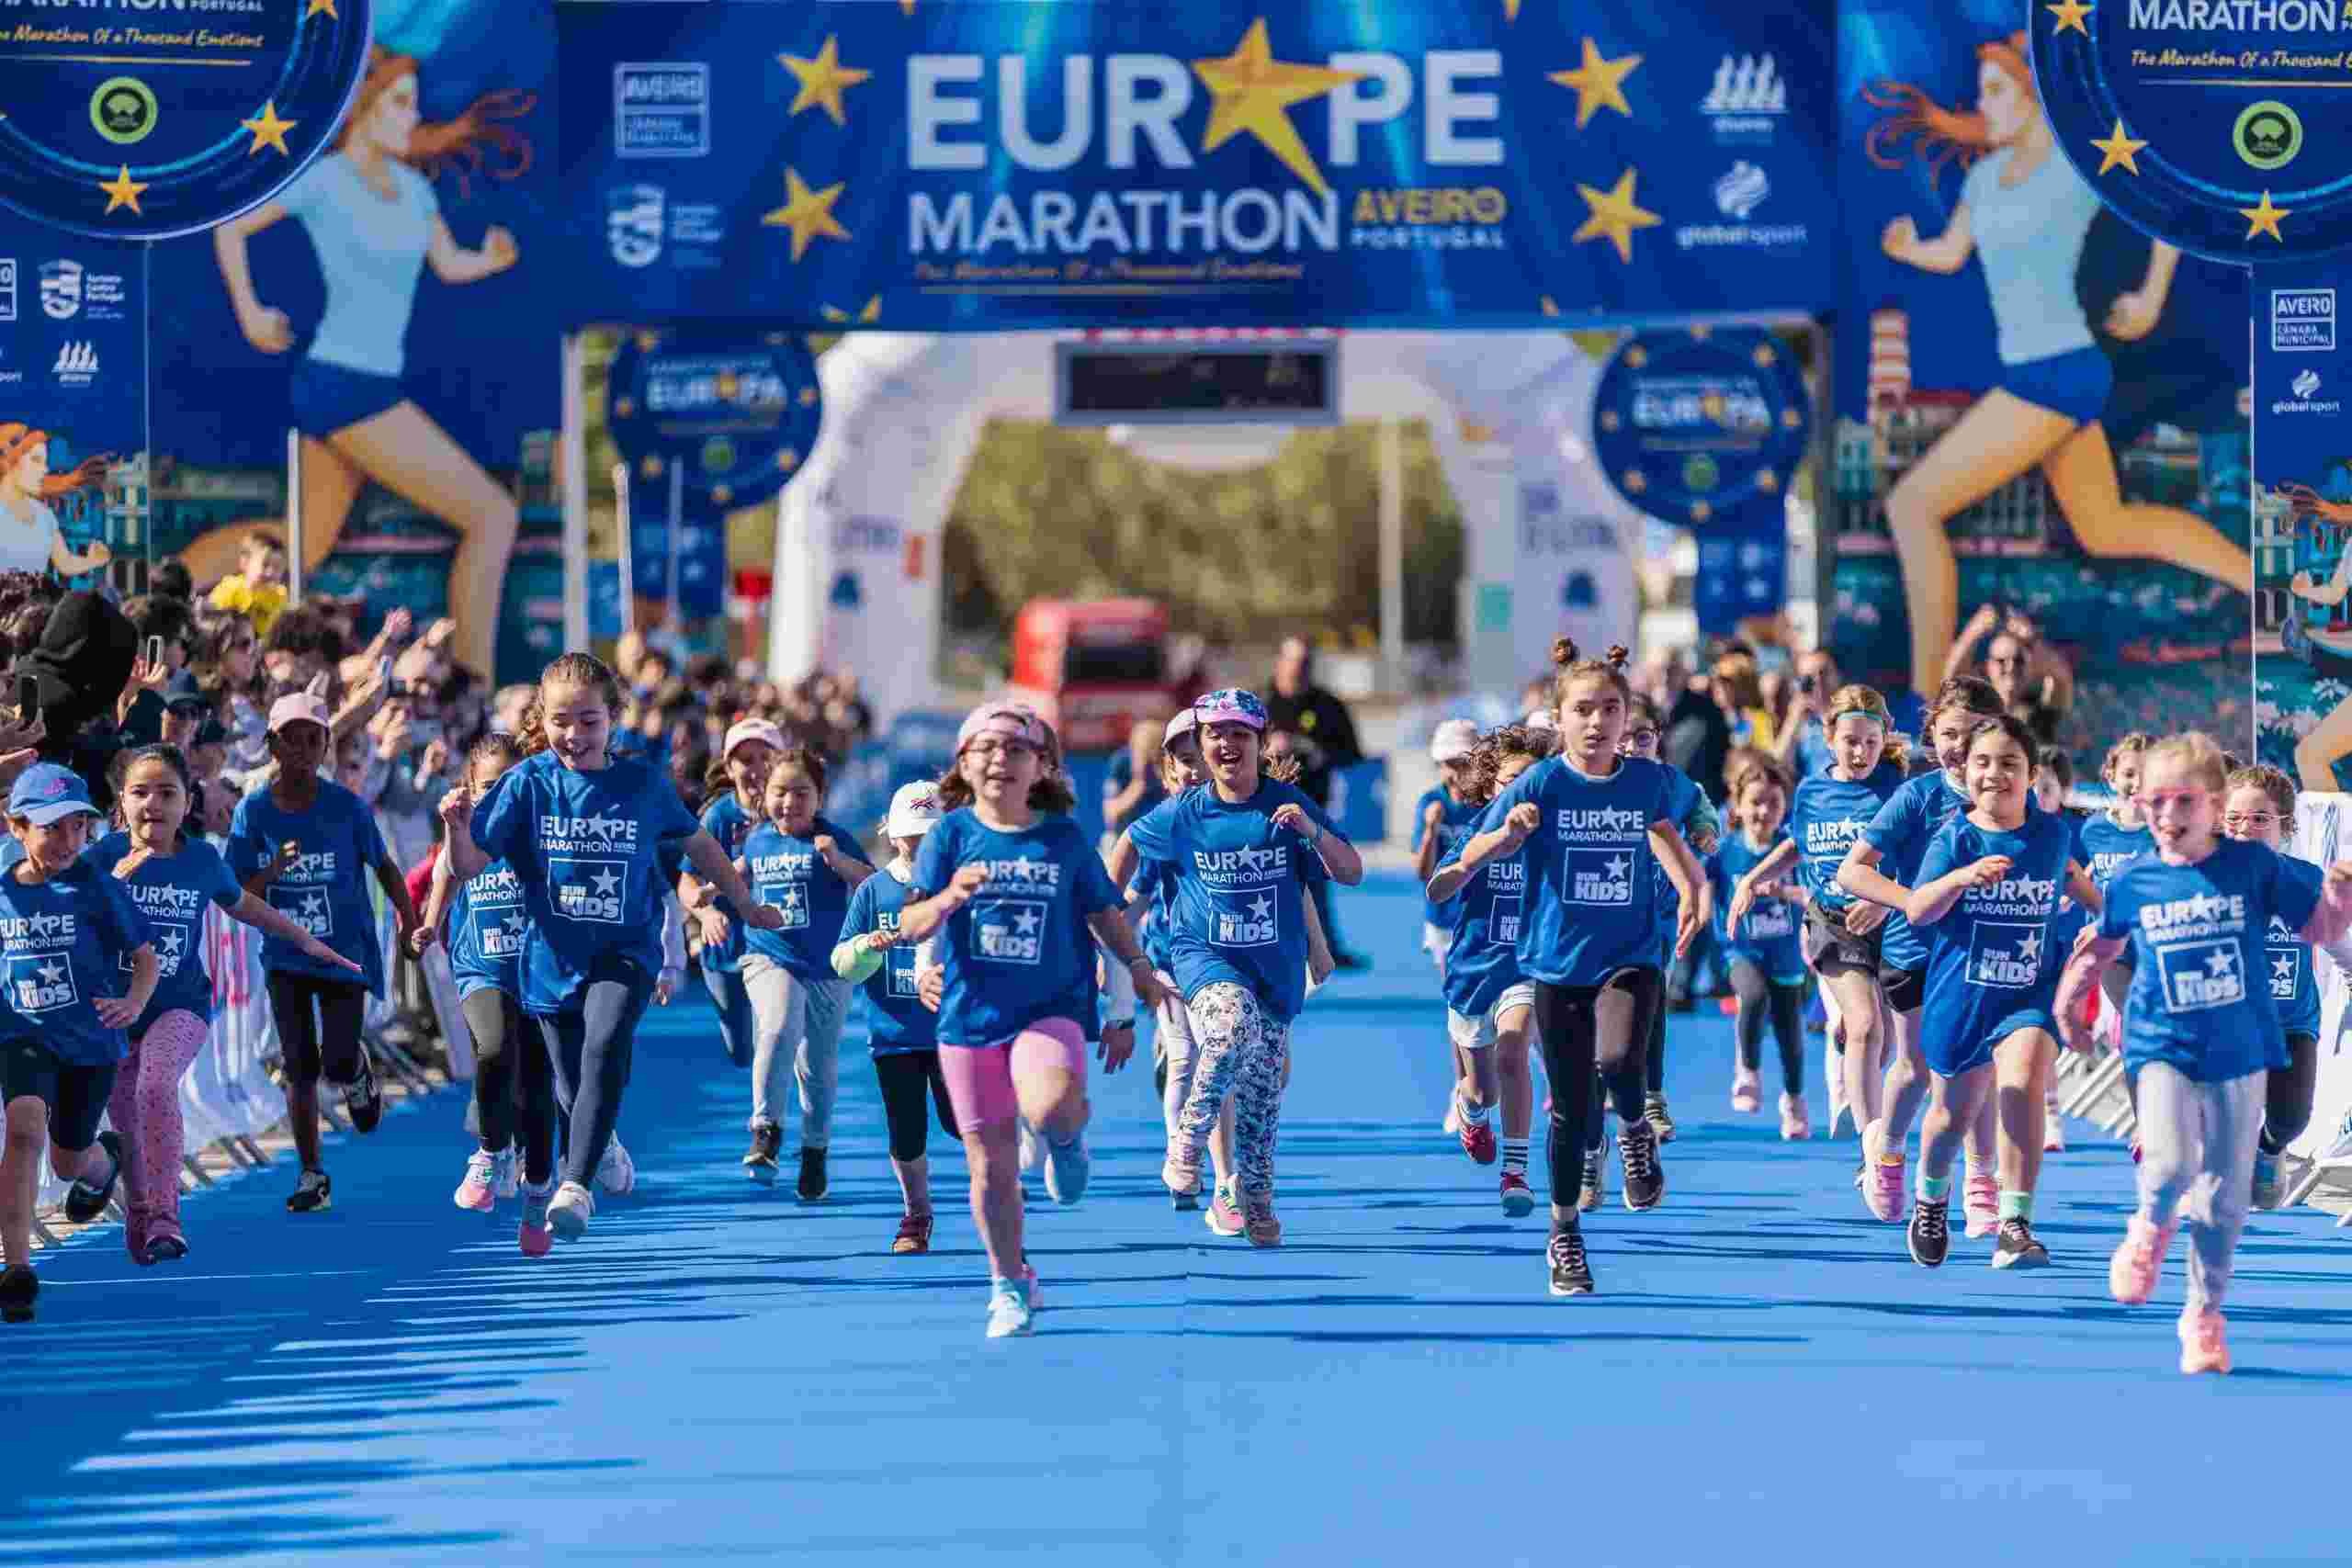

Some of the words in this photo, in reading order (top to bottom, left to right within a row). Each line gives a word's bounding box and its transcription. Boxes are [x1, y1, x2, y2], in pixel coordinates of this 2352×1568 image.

[2128, 0, 2336, 30] MARATHON
[2131, 50, 2156, 67] The
[2159, 50, 2235, 67] Marathon
[2239, 51, 2256, 70] Of
[2271, 50, 2342, 69] Thousand
[908, 52, 1505, 170] EURPE
[1352, 188, 1507, 227] AVEIRO
[908, 189, 1340, 254] MARATHON
[1351, 227, 1505, 251] PORTUGAL
[539, 814, 639, 840] EURPE
[1557, 805, 1645, 829] EURPE
[538, 840, 612, 853] MARATHON
[1193, 845, 1286, 872] EURPE
[752, 852, 814, 874] EURPE
[1574, 882, 1630, 900] KIDS
[1964, 875, 2056, 901] EURPE
[2139, 893, 2245, 931] EURPE
[1219, 919, 1273, 942] KIDS
[1979, 959, 2039, 985] KIDS
